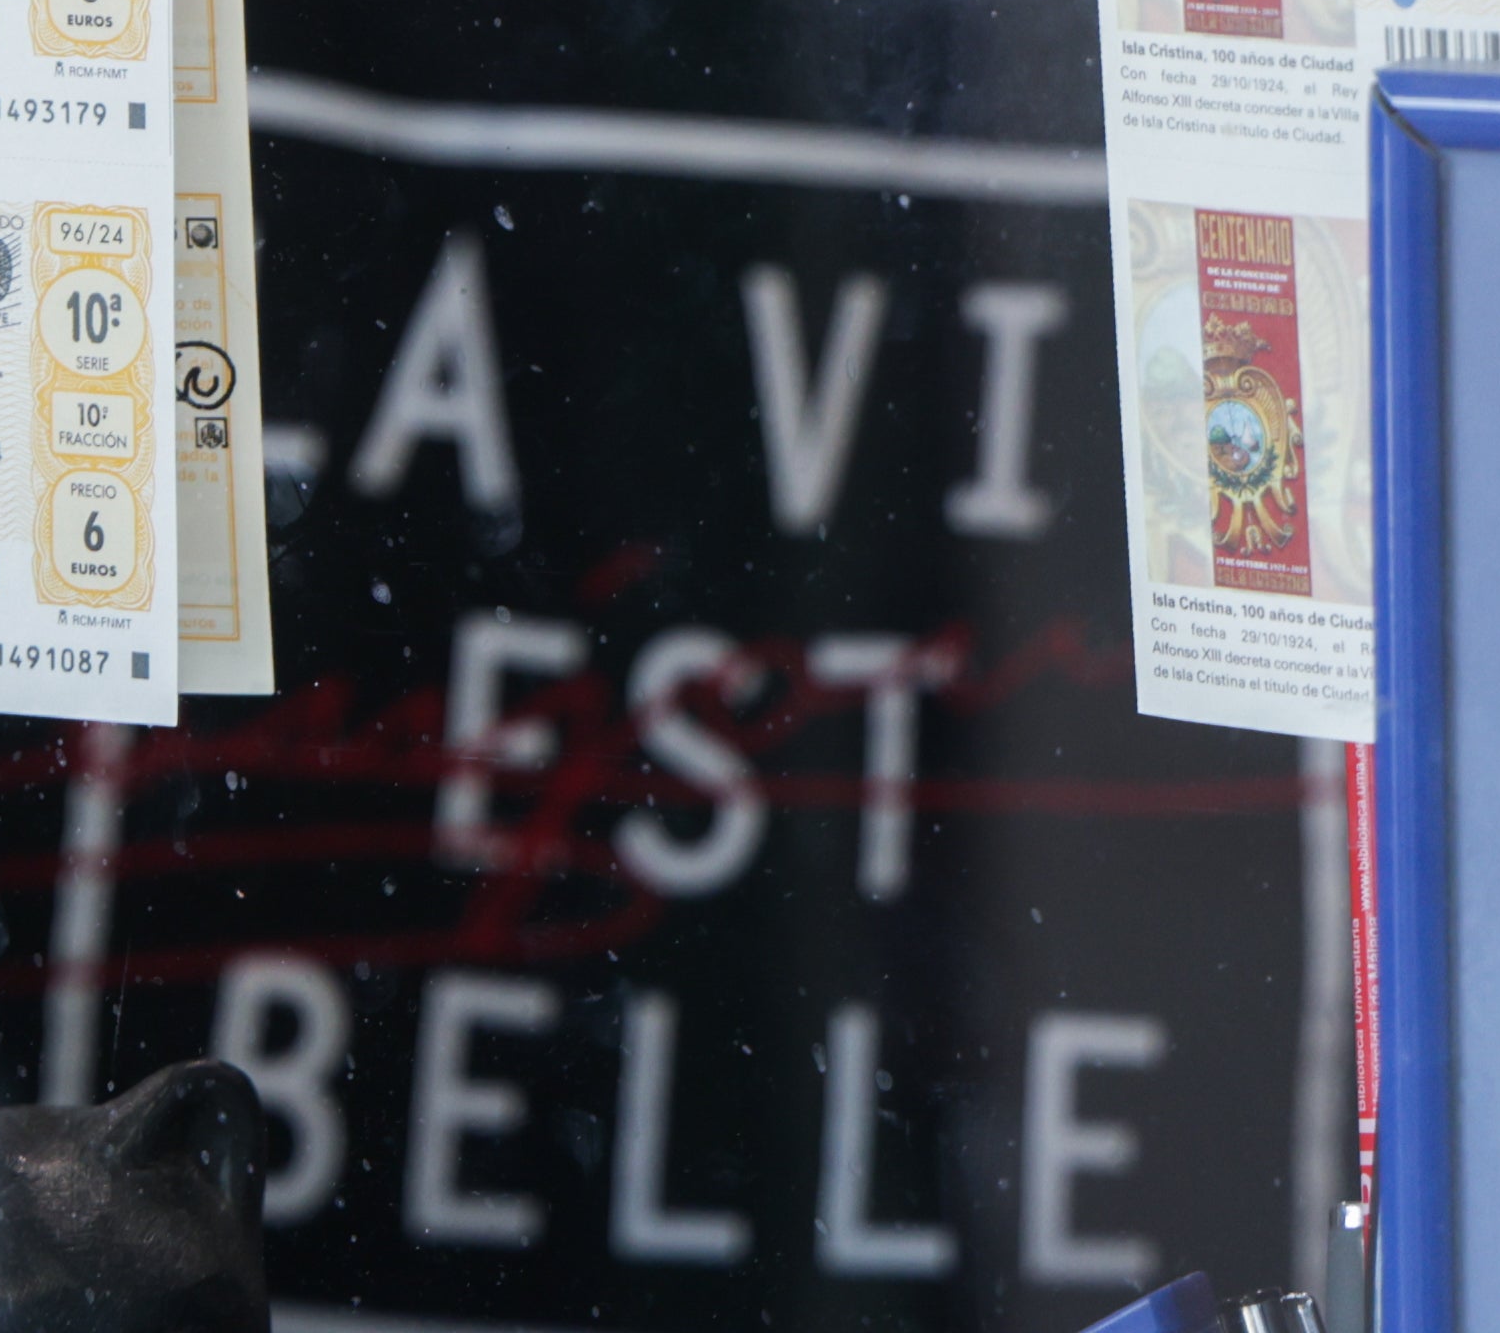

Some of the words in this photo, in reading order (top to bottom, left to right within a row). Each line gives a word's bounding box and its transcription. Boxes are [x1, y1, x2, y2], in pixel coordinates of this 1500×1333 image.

[67, 14, 114, 29] EUROS
[60, 222, 124, 245] 96/24
[75, 355, 110, 371] SERIE
[270, 232, 522, 513] A
[58, 430, 128, 449] FRACCIÓN
[70, 483, 117, 500] PRECIO
[83, 511, 105, 552] 6
[70, 561, 118, 578] EUROS
[1329, 613, 1375, 632] Ciuda
[433, 607, 961, 900] EST
[214, 953, 1168, 1283] BELLE
